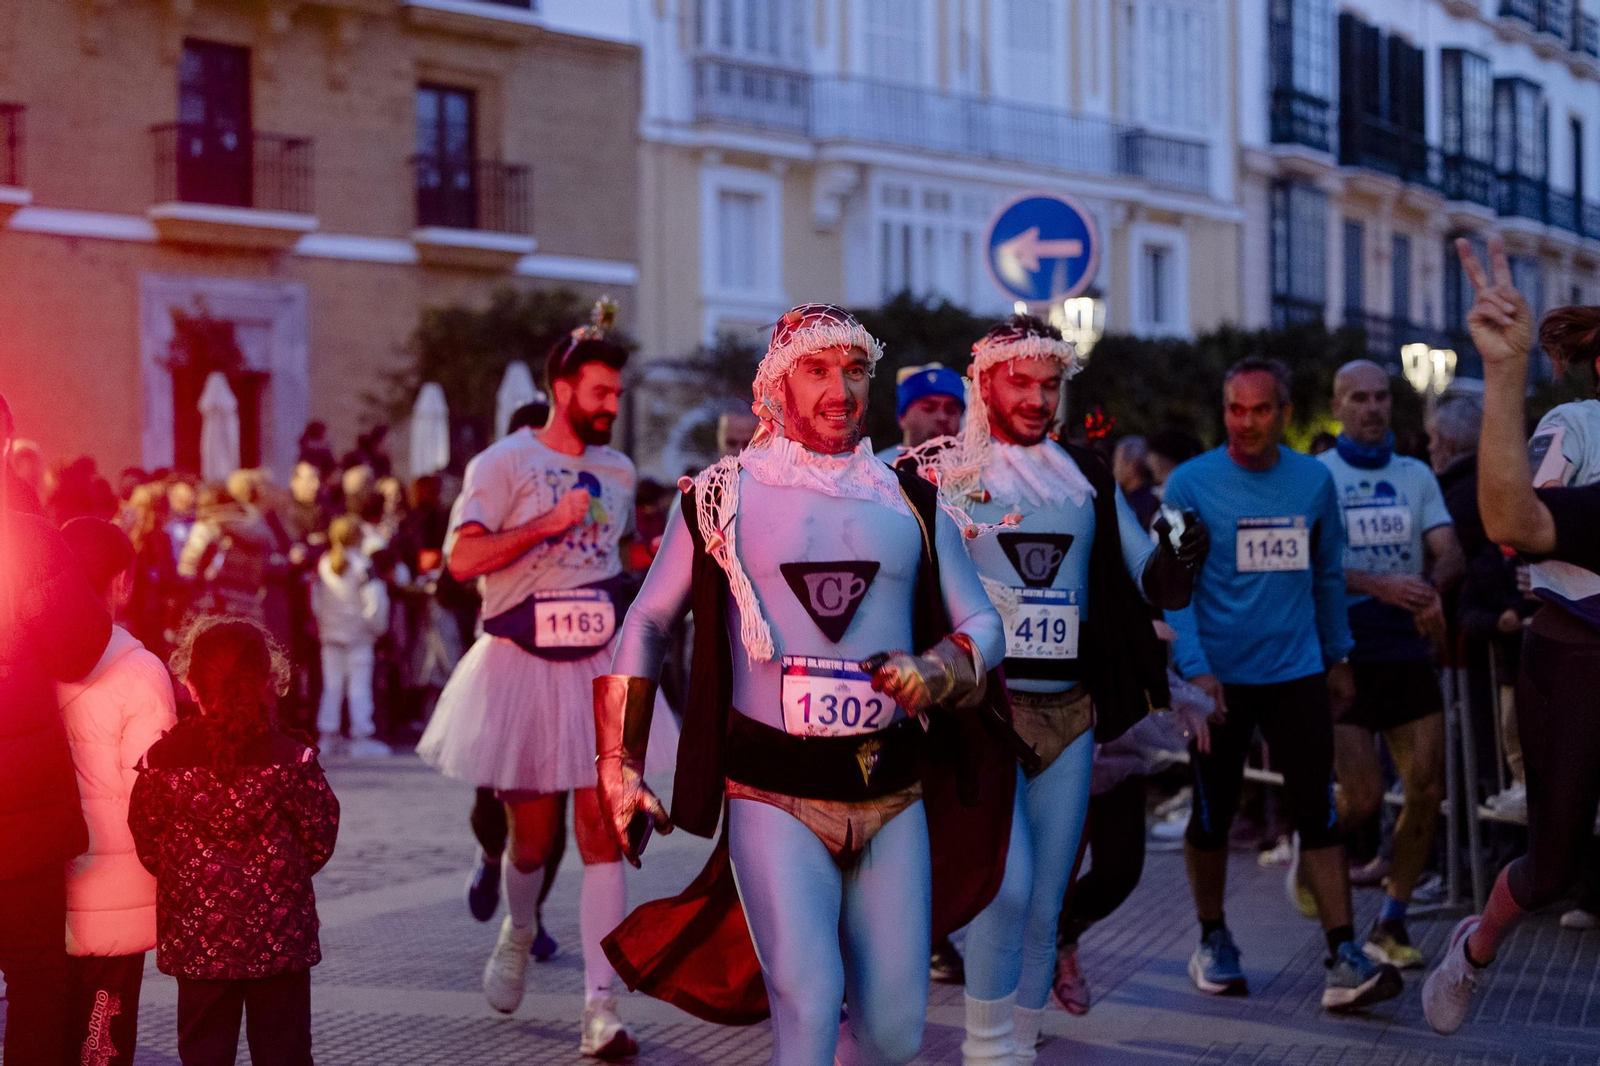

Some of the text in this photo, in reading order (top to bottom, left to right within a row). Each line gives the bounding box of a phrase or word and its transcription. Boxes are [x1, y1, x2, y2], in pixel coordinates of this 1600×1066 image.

[1245, 538, 1298, 558] 1143
[547, 612, 604, 633] 1163
[1015, 616, 1067, 644] 419
[797, 692, 883, 729] 1302
[86, 989, 109, 1050] OLIMPO
